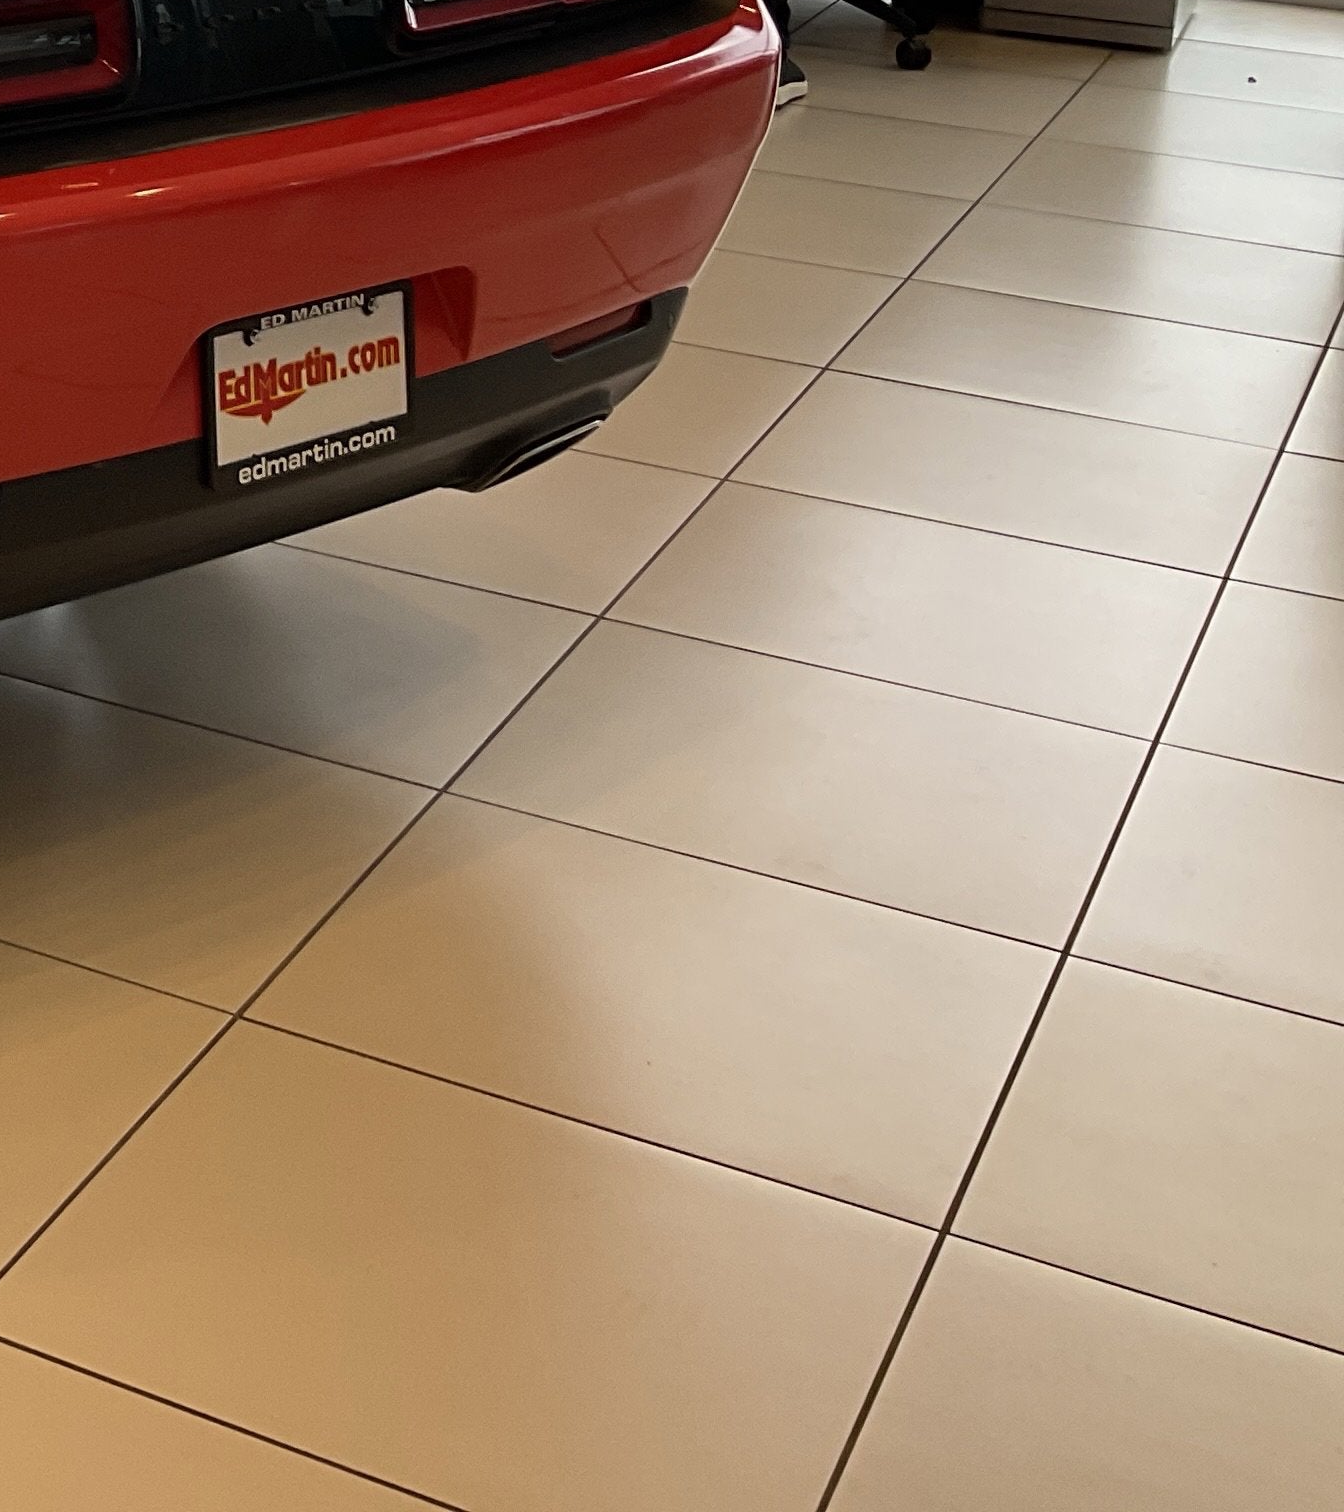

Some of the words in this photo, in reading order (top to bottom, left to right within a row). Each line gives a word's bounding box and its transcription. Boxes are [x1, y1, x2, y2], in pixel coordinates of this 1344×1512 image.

[259, 313, 286, 331] ED
[291, 293, 365, 322] MARTIN
[218, 335, 400, 424] EdMartin.com
[238, 425, 396, 485] edmartin.com
